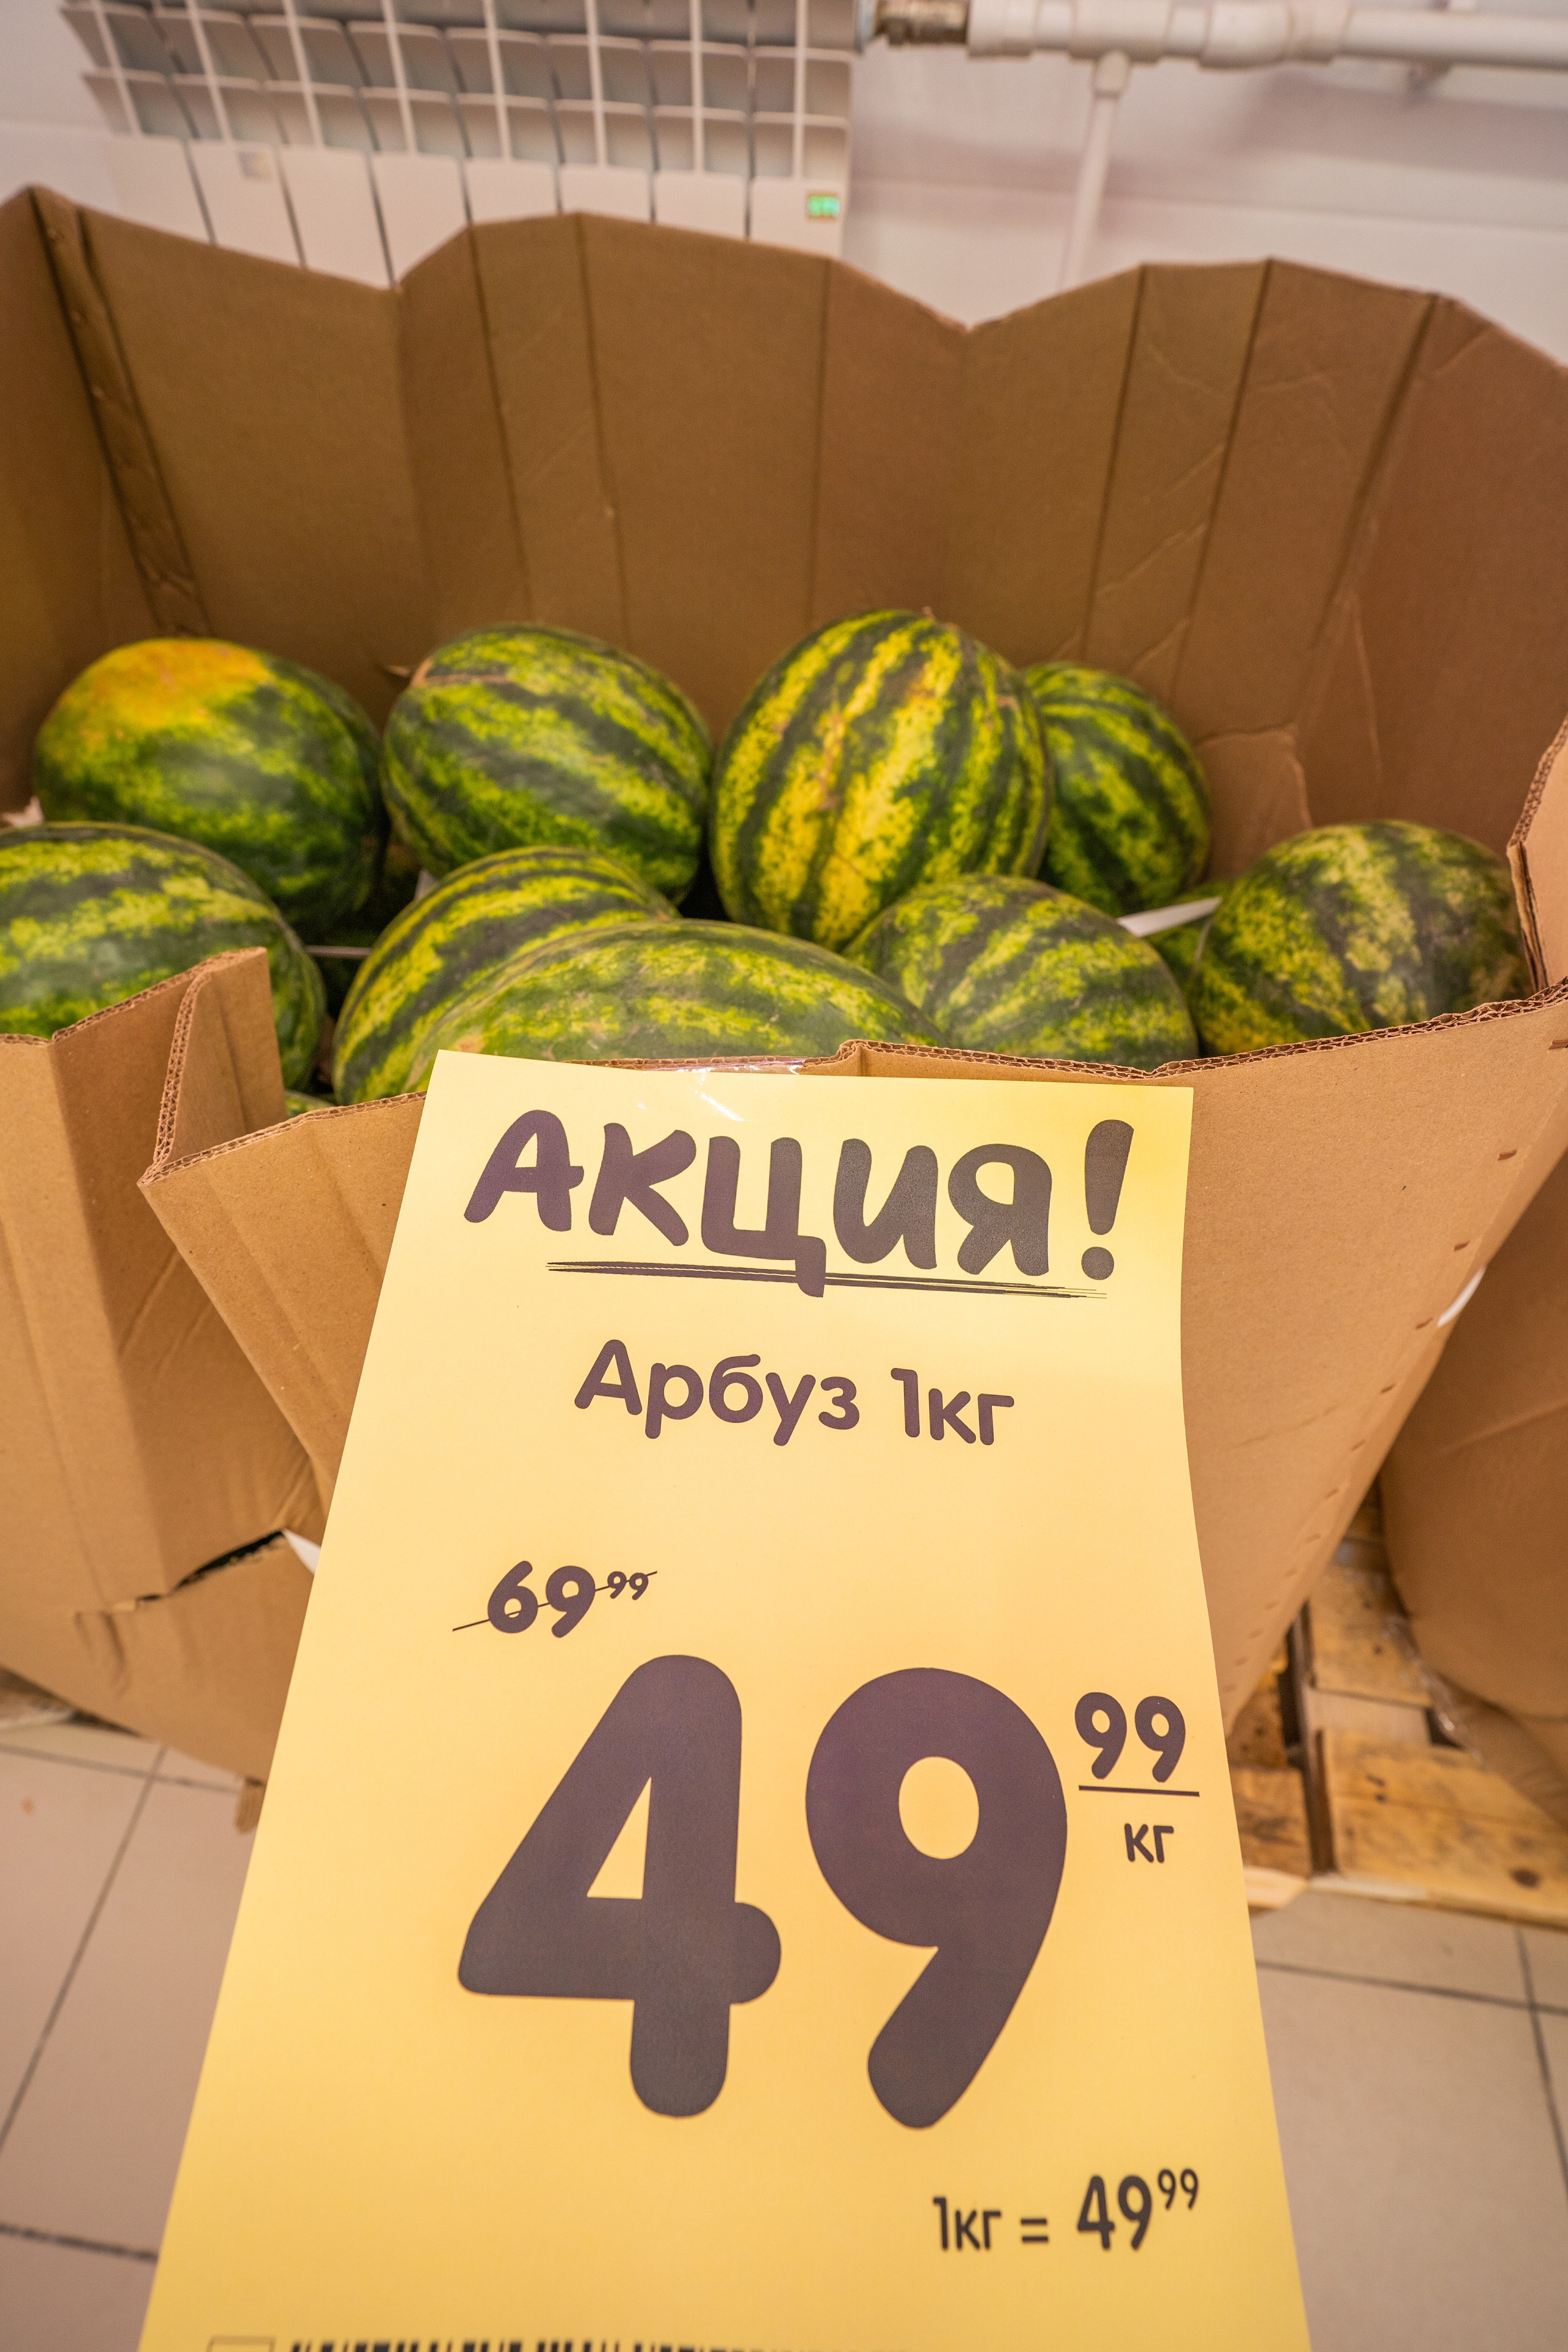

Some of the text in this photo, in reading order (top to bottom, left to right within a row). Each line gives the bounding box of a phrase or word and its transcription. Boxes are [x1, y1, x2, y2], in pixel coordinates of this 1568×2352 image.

[464, 1110, 1134, 1297] АКЦИЯ!
[574, 1339, 1015, 1446] Арбуз 1кг
[488, 1561, 596, 1638] 69
[1124, 1823, 1174, 1863] кг
[458, 1654, 1186, 2129] 49 99
[933, 2196, 1001, 2250] 1кг
